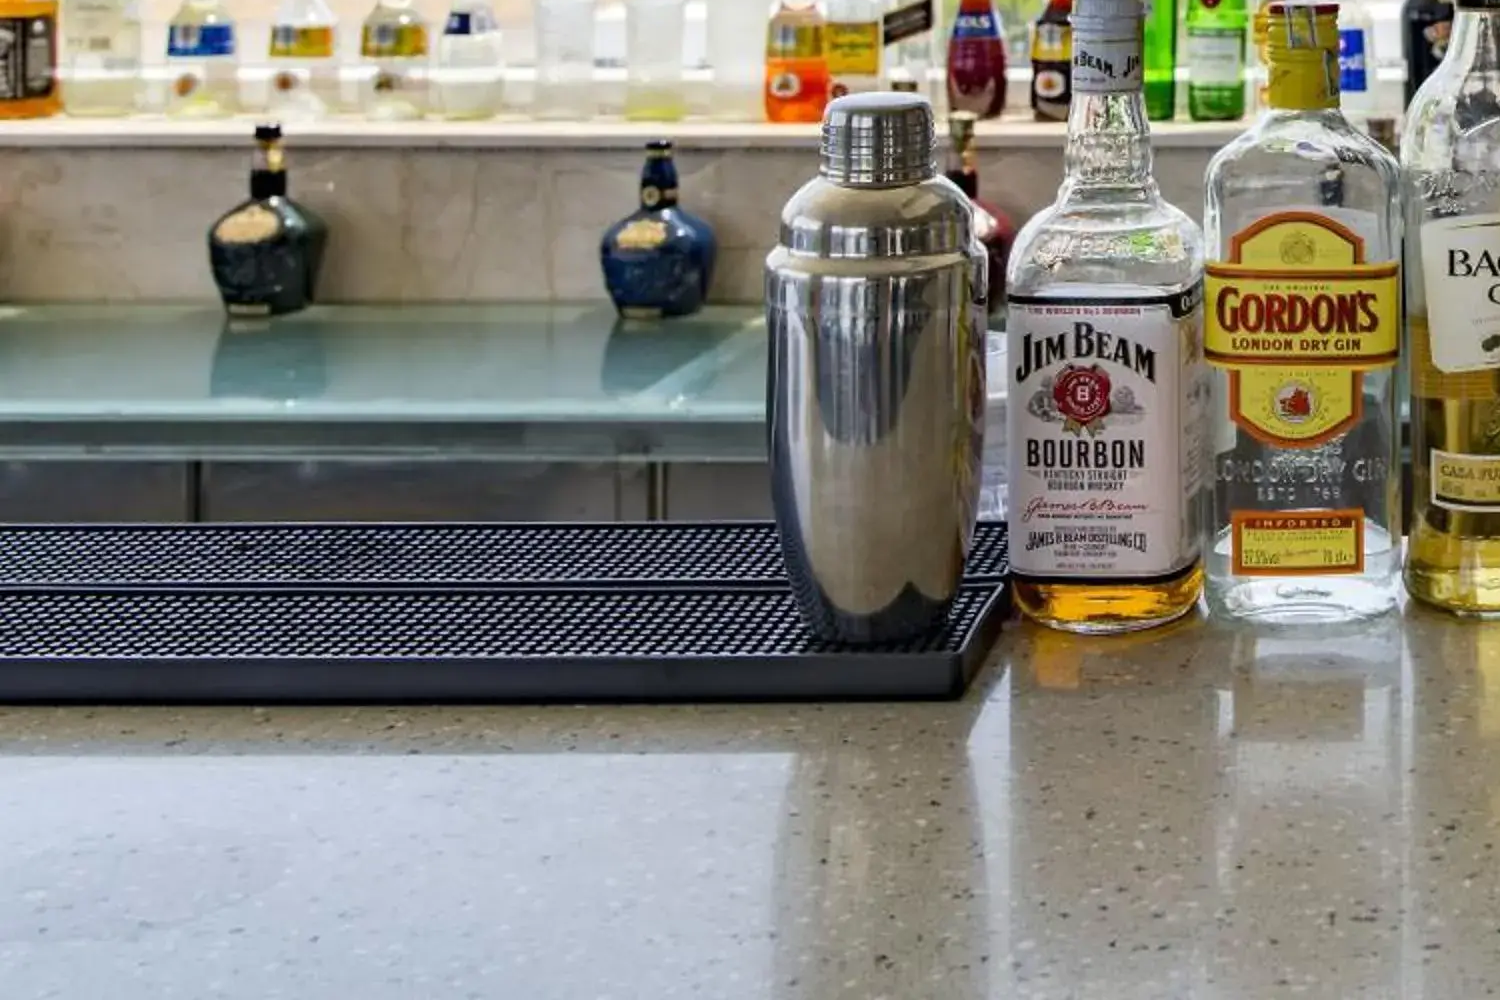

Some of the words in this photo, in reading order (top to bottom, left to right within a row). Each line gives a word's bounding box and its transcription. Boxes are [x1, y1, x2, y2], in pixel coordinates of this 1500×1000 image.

[1080, 51, 1117, 79] BEAM
[1215, 285, 1379, 334] GORDON'S
[1016, 332, 1068, 384] JIM
[1072, 321, 1157, 385] BEAM
[1231, 337, 1293, 351] LONDON
[1300, 338, 1329, 351] DRY
[1334, 338, 1361, 351] GIN
[1026, 439, 1145, 469] BOURBON
[1254, 518, 1342, 528] IMPORTED
